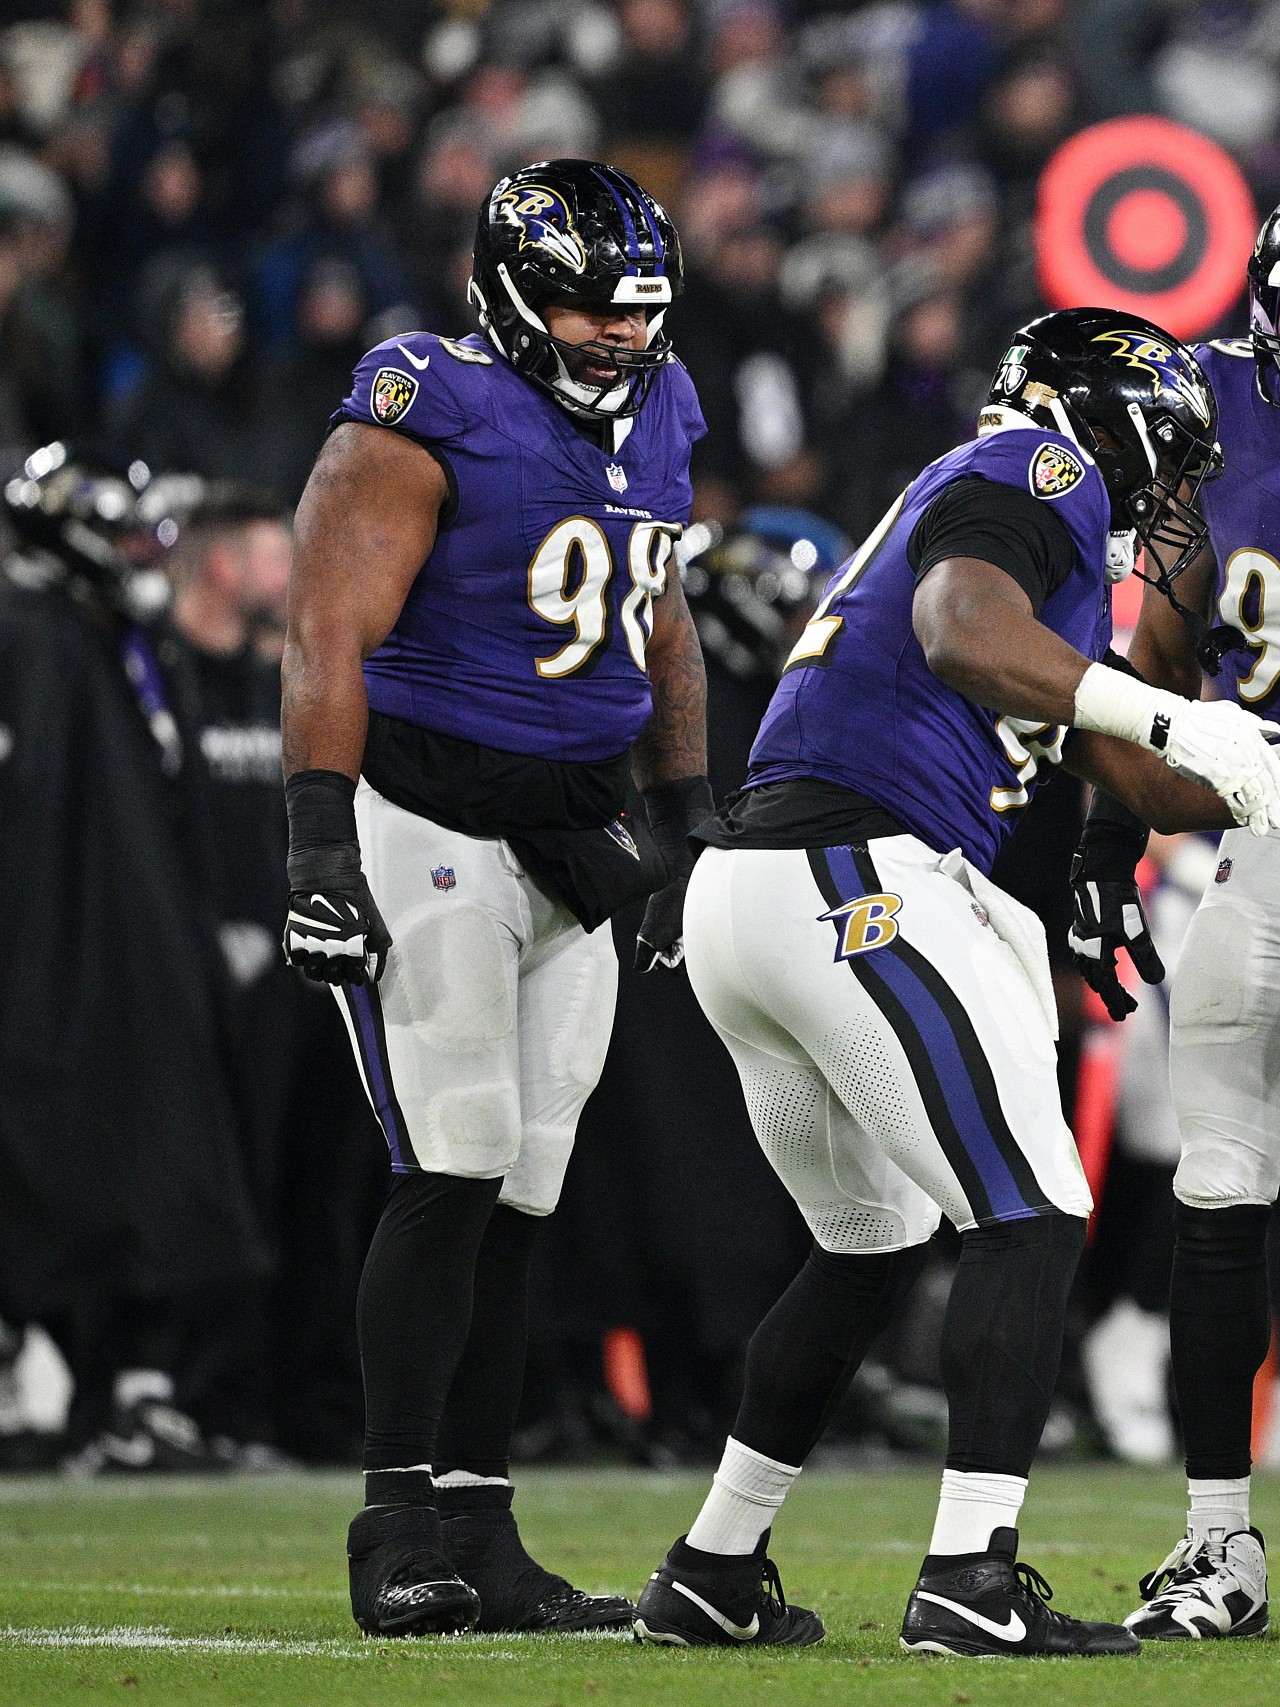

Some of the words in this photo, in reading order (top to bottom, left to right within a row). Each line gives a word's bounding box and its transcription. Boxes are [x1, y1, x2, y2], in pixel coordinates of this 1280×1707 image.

[635, 283, 662, 293] RAVENS
[381, 371, 413, 390] RAVENS
[1046, 446, 1081, 473] RAVENS
[603, 503, 653, 519] RAVENS
[528, 514, 683, 679] 98
